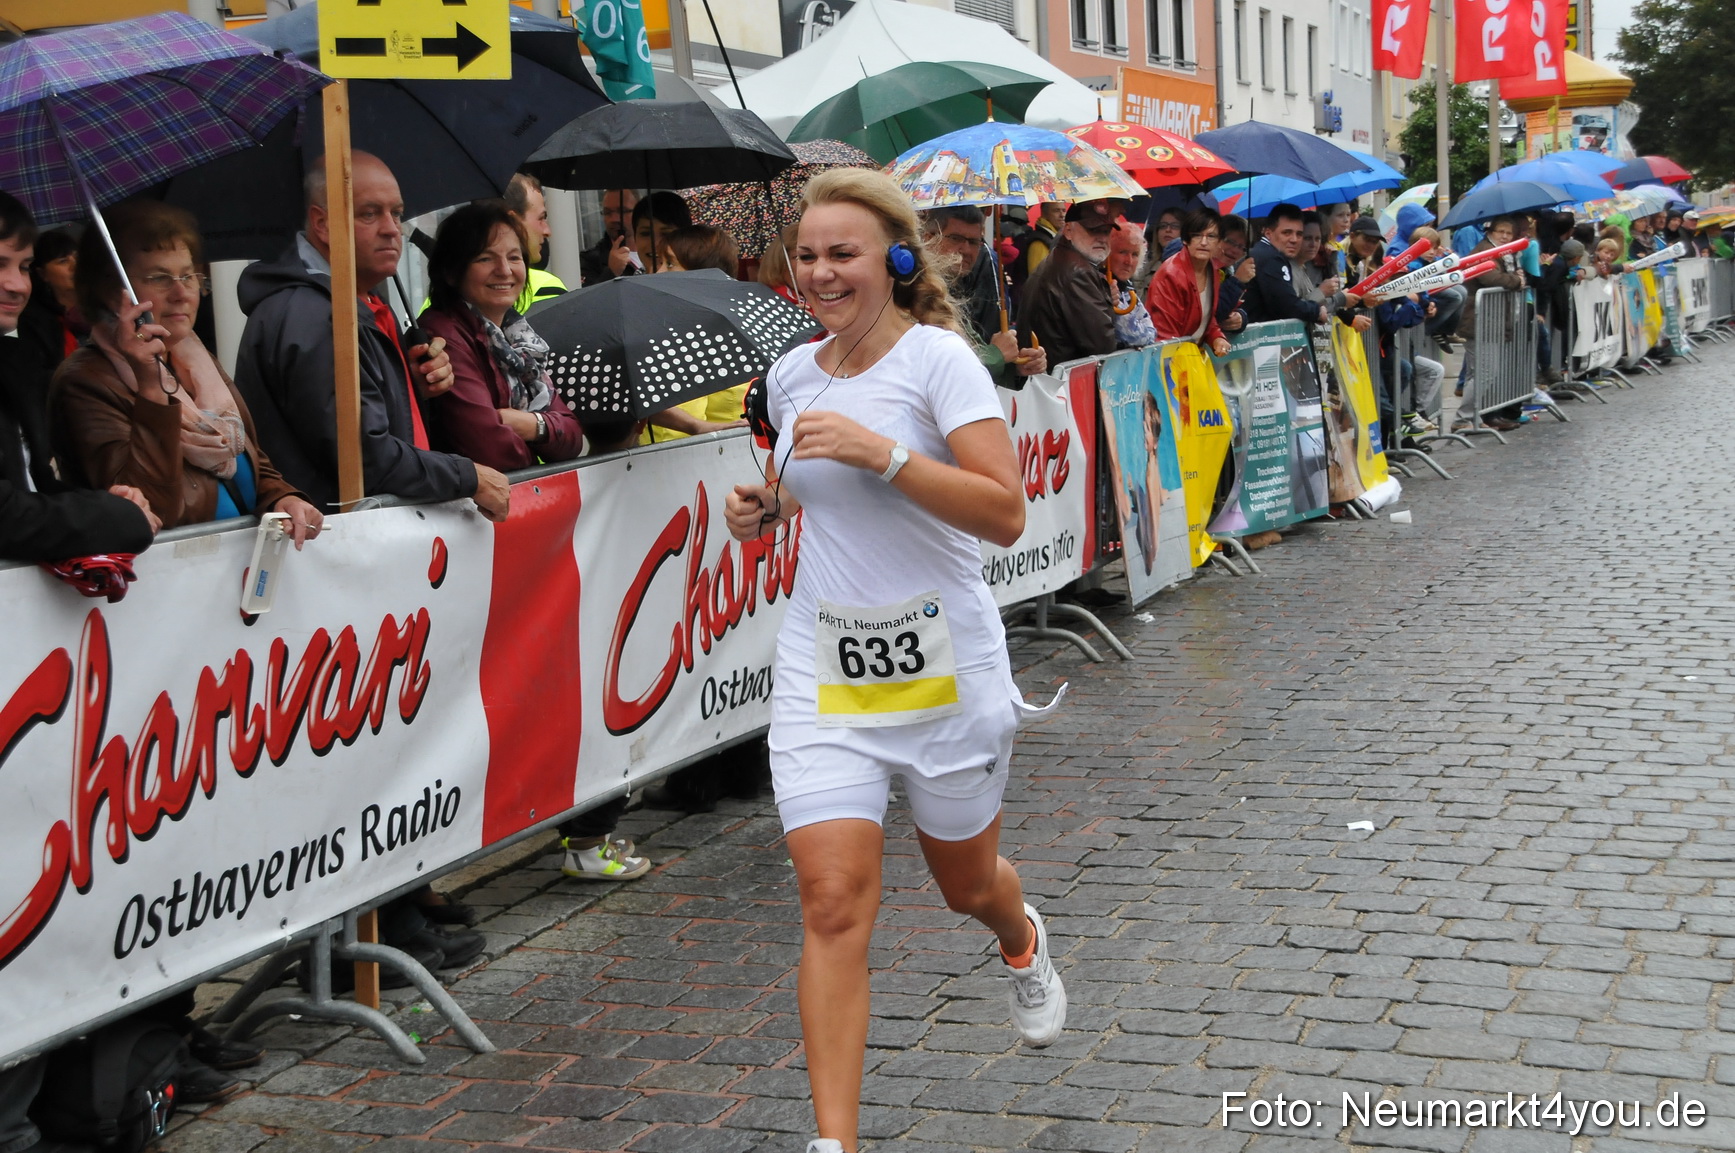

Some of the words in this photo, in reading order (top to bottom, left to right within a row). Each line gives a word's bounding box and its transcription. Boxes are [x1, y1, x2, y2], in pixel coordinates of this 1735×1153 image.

[1282, 265, 1291, 281] 3
[1417, 264, 1438, 281] BMW
[1362, 278, 1378, 293] Audi
[819, 611, 852, 630] PARTL
[854, 610, 919, 631] Neumarkt
[838, 631, 925, 679] 633
[114, 826, 346, 960] Ostbayerns
[361, 778, 462, 862] Radio
